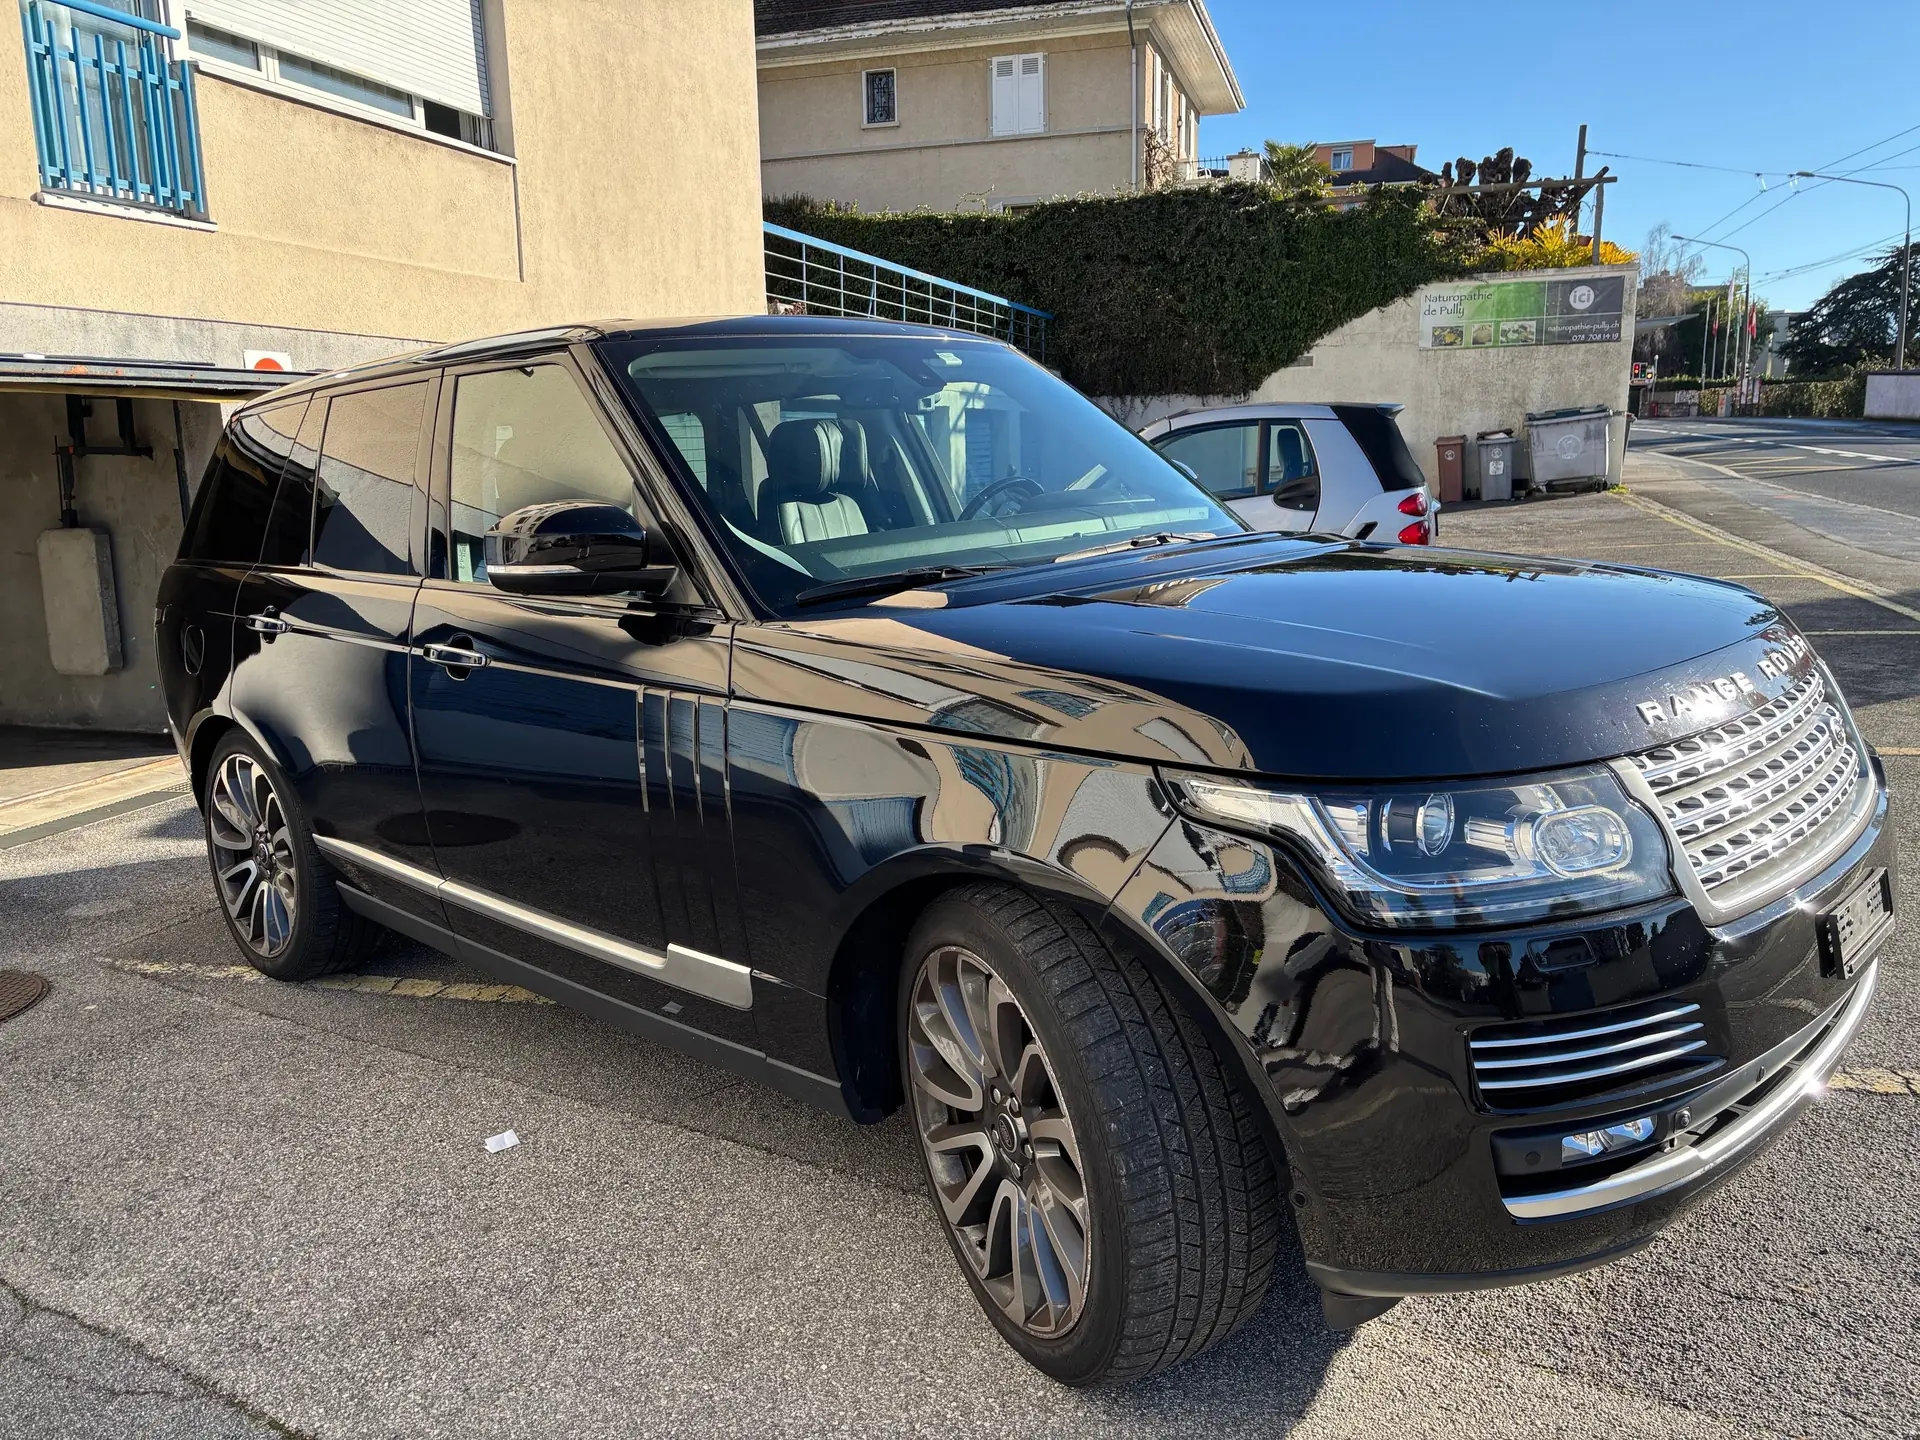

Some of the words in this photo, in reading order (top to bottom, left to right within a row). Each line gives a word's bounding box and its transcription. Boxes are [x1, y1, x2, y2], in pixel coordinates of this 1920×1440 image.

[1424, 289, 1493, 306] Naturopathie
[1573, 289, 1591, 303] ici
[1423, 306, 1437, 316] de
[1439, 303, 1465, 318] Pully
[1547, 320, 1620, 334] naturopathie-pully.ch
[1636, 672, 1754, 727] RANGE
[1757, 635, 1808, 681] ROVER
